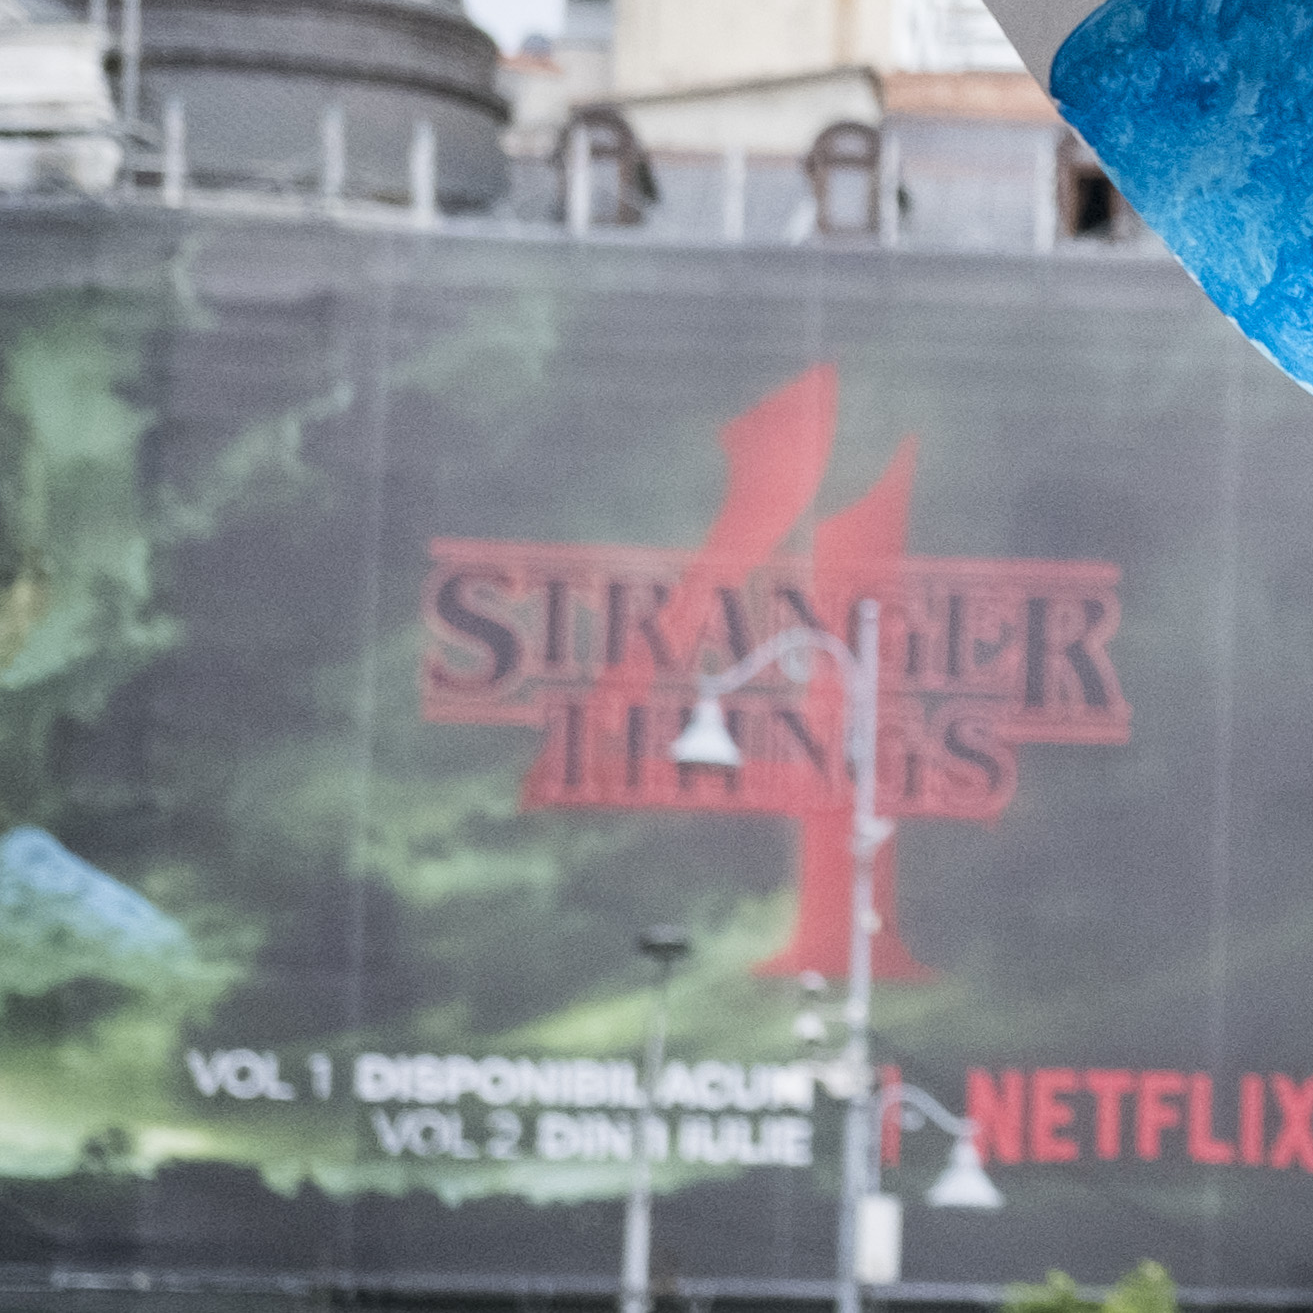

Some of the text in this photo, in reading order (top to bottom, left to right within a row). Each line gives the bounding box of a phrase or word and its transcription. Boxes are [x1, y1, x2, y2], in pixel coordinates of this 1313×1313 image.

[186, 1047, 295, 1101] VOL
[308, 1050, 334, 1101] 1
[353, 1051, 648, 1110] DISPONIBIL
[372, 1108, 478, 1160] VOL
[486, 1110, 524, 1161] 2
[536, 1112, 633, 1162] DIN
